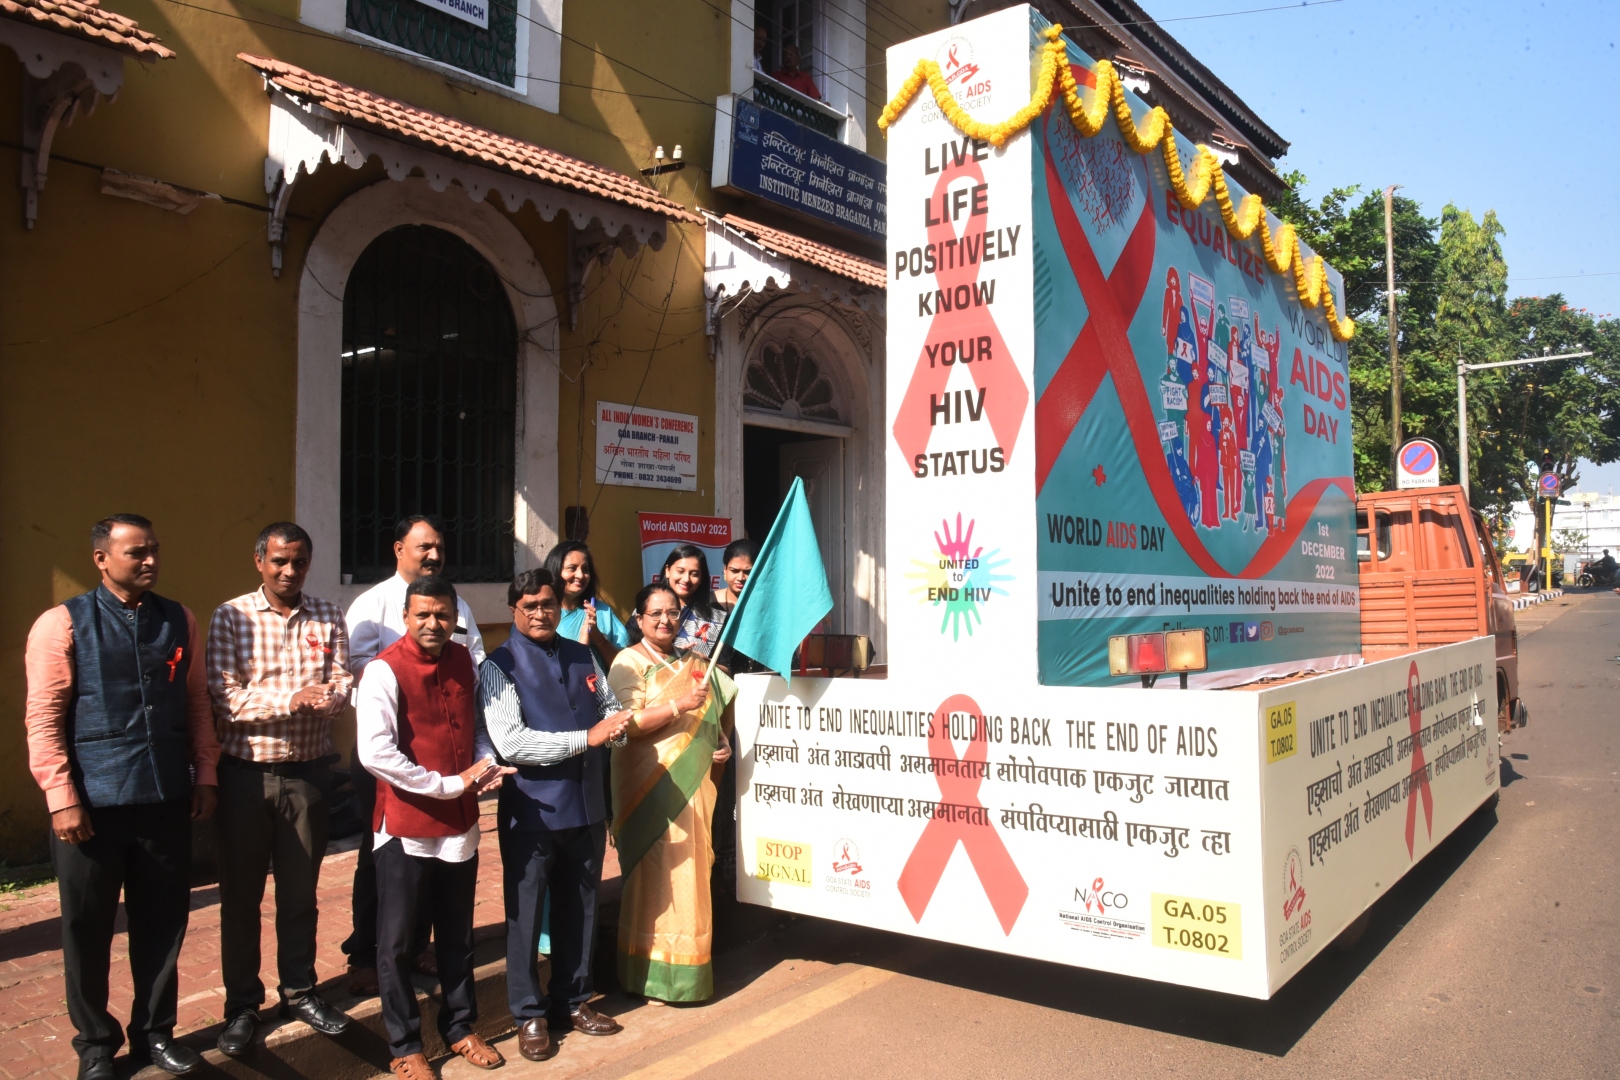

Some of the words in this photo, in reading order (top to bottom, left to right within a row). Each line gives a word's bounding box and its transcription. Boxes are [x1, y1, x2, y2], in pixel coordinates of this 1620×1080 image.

[449, 0, 484, 20] BRANCH
[966, 80, 992, 99] AIDS
[924, 135, 989, 176] LIVE
[759, 173, 800, 202] INSTITUTE
[801, 190, 834, 216] MENEZES
[835, 204, 872, 233] BRAGANZA,
[873, 219, 887, 235] PAN
[925, 183, 989, 228] LIFE
[1166, 189, 1265, 286] EQUALIZE
[895, 224, 1021, 281] POSITIVELY
[918, 279, 996, 317] KNOW
[1287, 305, 1343, 363] WORLD
[925, 335, 993, 369] YOUR
[1290, 346, 1347, 411] AIDS
[1167, 386, 1181, 397] FIGHT
[930, 387, 987, 427] HIV
[601, 409, 612, 422] ALL
[613, 411, 629, 424] INDIA
[632, 413, 659, 429] WOMEN'S
[661, 417, 694, 433] CONFERENCE
[1303, 403, 1339, 445] DAY
[618, 429, 630, 439] GOA
[603, 443, 625, 456] अखिल
[627, 445, 649, 458] भारतीय
[652, 448, 671, 461] महिला
[914, 446, 1005, 479] STATUS
[614, 471, 634, 479] PHONE
[638, 473, 654, 481] 0832
[643, 520, 667, 532] World
[668, 521, 689, 532] AIDS
[690, 523, 707, 534] DAY
[708, 524, 728, 535] 2022
[1047, 513, 1102, 547] WORLD
[1106, 520, 1137, 550] AIDS
[1141, 524, 1165, 552] DAY
[1317, 521, 1329, 537] 1st
[1301, 541, 1345, 560] DECEMBER
[939, 559, 979, 570] UNITED
[952, 572, 963, 581] to
[1315, 564, 1335, 580] 2022
[928, 587, 959, 602] END
[964, 587, 991, 602] HIV
[1052, 579, 1100, 607] Unite
[1106, 583, 1122, 606] to
[1127, 583, 1155, 606] end
[1160, 582, 1235, 612] inequalities
[1238, 585, 1276, 611] holding
[1278, 587, 1300, 605] back
[1301, 588, 1315, 605] the
[1316, 589, 1330, 605] end
[1332, 589, 1339, 605] of
[1340, 590, 1356, 606] AIDS
[1271, 707, 1292, 729] GA.05
[1310, 714, 1336, 758] UNITE
[1338, 709, 1349, 746] TO
[1353, 703, 1368, 740] END
[1370, 688, 1411, 732] INEQUALITIES
[1434, 675, 1447, 704] BACK
[1449, 671, 1458, 698] THE
[1459, 668, 1467, 693] END
[759, 704, 791, 729] UNITE
[797, 706, 811, 731] TO
[819, 707, 842, 733] END
[850, 709, 935, 739] INEQUALITIES
[942, 713, 1003, 744] HOLDING
[1011, 716, 1052, 747] BACK
[1066, 719, 1096, 750] THE
[1106, 721, 1138, 752] END
[1147, 724, 1168, 754] OF
[1176, 725, 1218, 758] AIDS
[1271, 734, 1293, 757] T.0802
[808, 742, 830, 766] अंत
[900, 754, 991, 780] असमानताय
[1093, 770, 1155, 803] एकजुट
[1164, 776, 1230, 801] जायात
[1347, 754, 1362, 789] अंत
[801, 782, 823, 807] अंत
[908, 798, 989, 826] असमानता
[1125, 822, 1190, 858] एकजुट
[1344, 802, 1359, 838] अंत
[766, 842, 802, 860] STOP
[759, 862, 810, 883] SIGNAL
[838, 877, 852, 886] STATE
[854, 879, 870, 889] AIDS
[826, 885, 849, 895] CONTROL
[1074, 886, 1128, 912] NACO
[1059, 912, 1079, 921] National
[1093, 918, 1111, 926] Control
[1113, 921, 1145, 931] Organisation
[1164, 900, 1227, 924] GA.05
[1300, 909, 1311, 930] AIDS
[1163, 926, 1229, 953] T.0802
